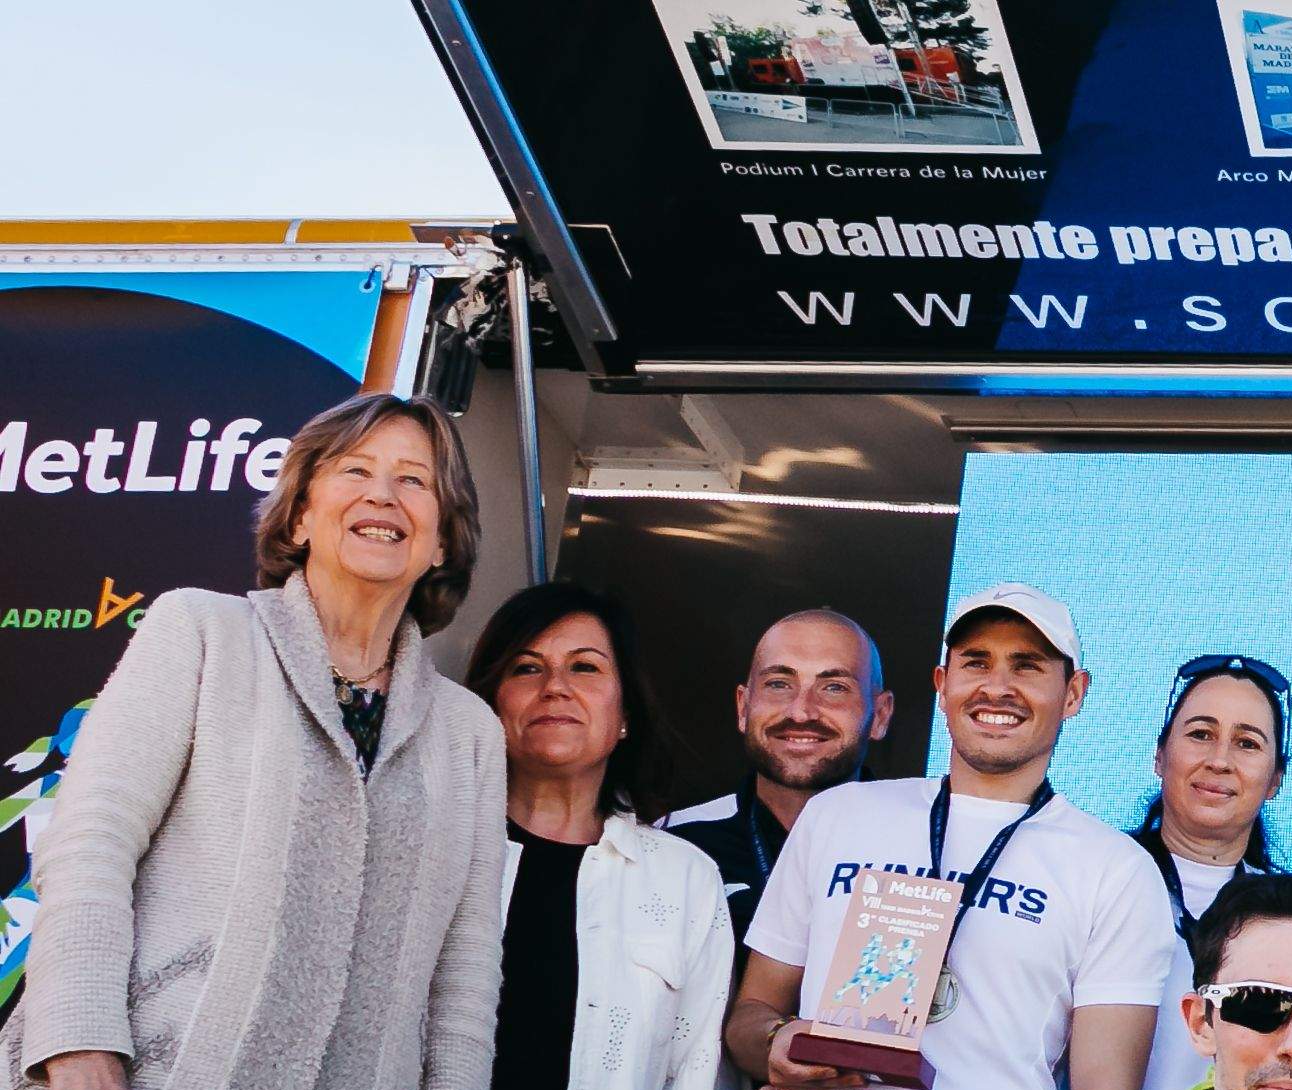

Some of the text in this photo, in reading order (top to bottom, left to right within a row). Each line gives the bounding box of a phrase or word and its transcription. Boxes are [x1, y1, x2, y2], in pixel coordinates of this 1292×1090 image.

[720, 162, 804, 176] Podium
[826, 164, 911, 178] Carrera
[919, 165, 946, 178] de
[953, 165, 973, 179] la
[982, 166, 1047, 182] Mujer
[1217, 169, 1269, 182] Arco
[741, 213, 1100, 260] Totalmente
[0, 609, 92, 629] ADRID
[888, 879, 953, 904] MetLife
